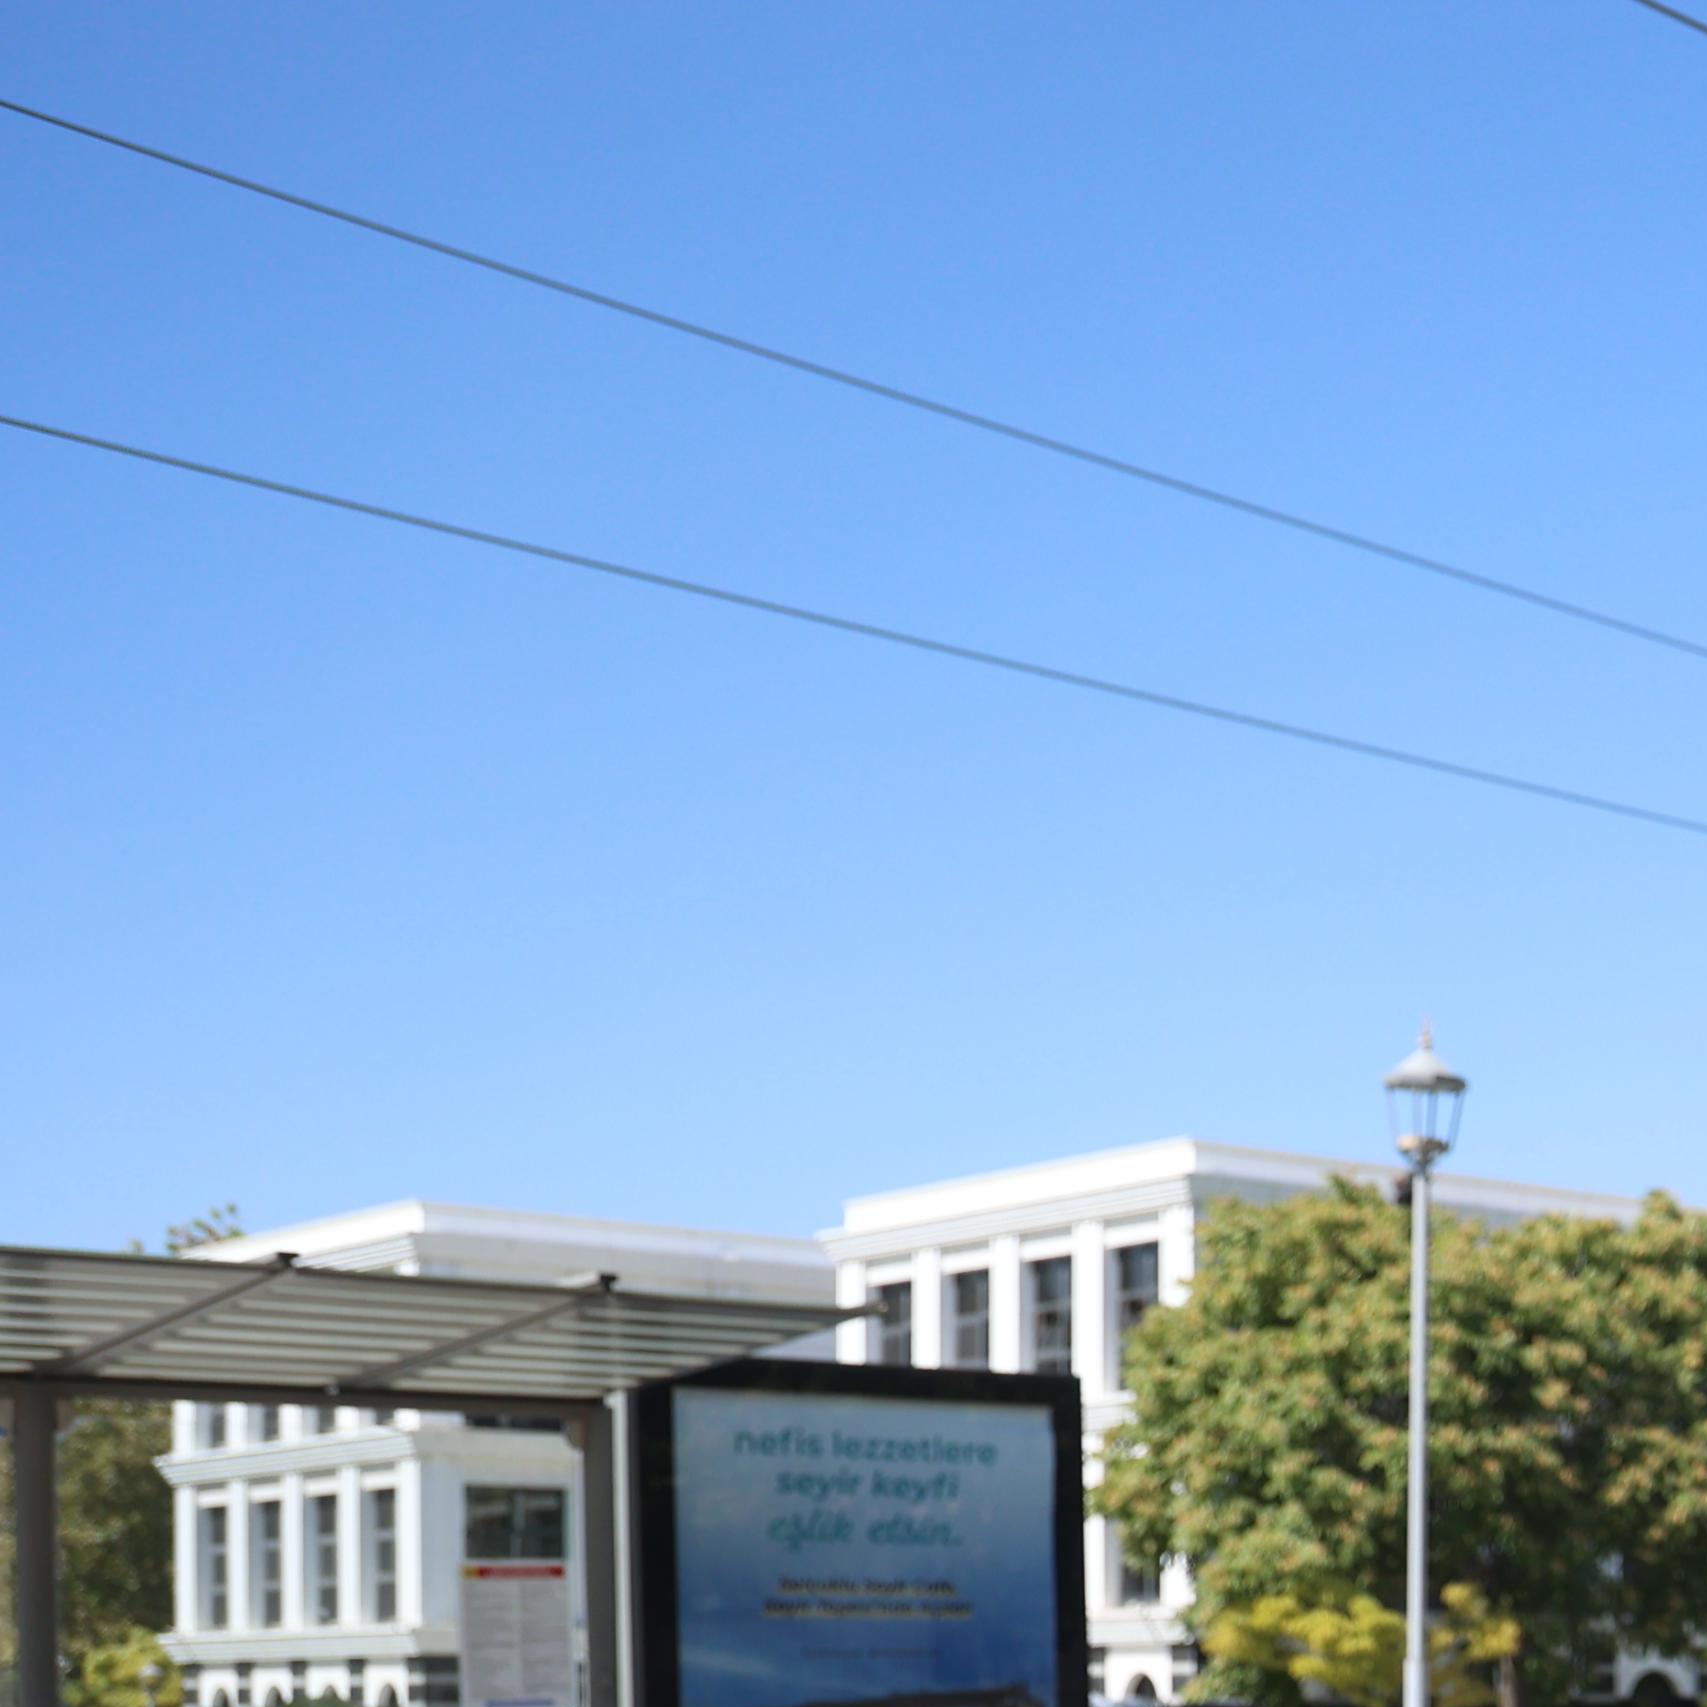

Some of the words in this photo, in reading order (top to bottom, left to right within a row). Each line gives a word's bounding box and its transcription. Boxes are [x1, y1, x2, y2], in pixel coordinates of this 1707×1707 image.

[733, 1426, 821, 1458] nefis
[831, 1430, 998, 1467] lezzetlere
[776, 1468, 862, 1502] seyir
[871, 1469, 961, 1502] keyfi
